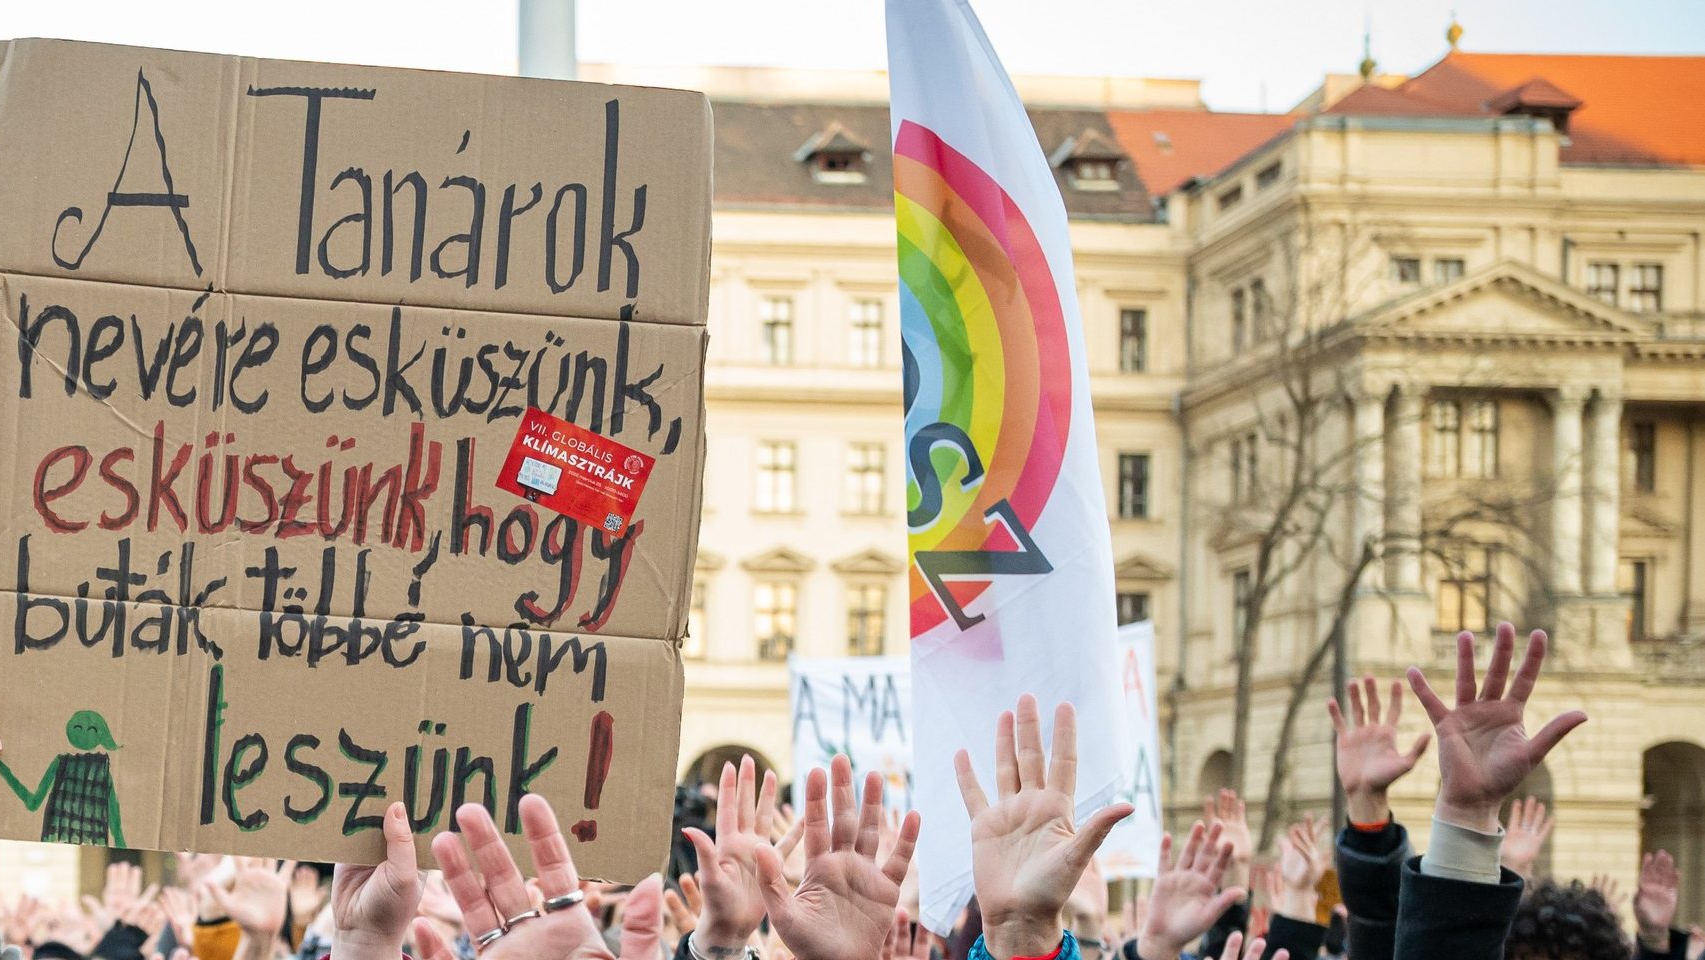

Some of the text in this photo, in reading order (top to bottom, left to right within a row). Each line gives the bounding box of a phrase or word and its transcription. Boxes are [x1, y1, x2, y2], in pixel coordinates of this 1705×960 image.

[52, 66, 648, 299] A Tanárok
[18, 283, 683, 456] nevére esküszünk,
[529, 420, 549, 438] VII.
[551, 430, 614, 465] GLOBÁLIS
[450, 436, 645, 633] hogy
[522, 433, 636, 491] KLÍMASZTRÁJK
[14, 534, 608, 703] buták többé nem
